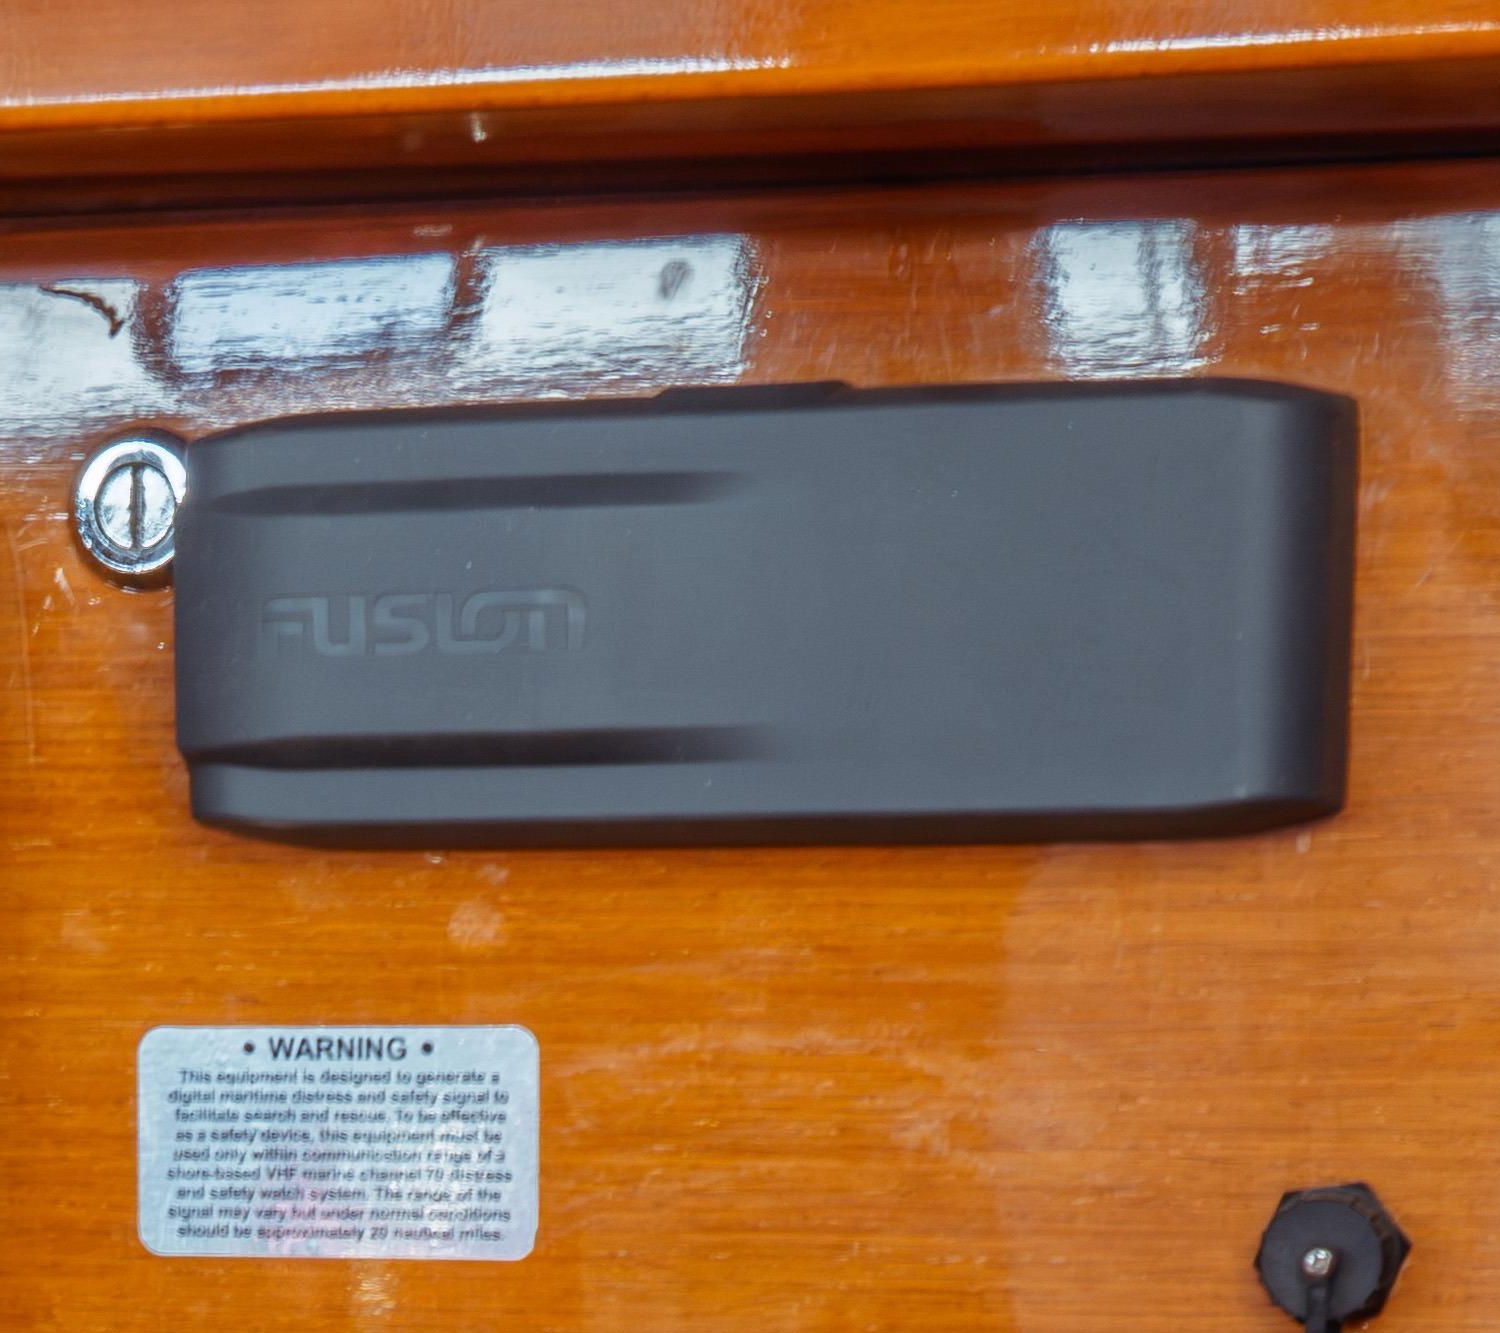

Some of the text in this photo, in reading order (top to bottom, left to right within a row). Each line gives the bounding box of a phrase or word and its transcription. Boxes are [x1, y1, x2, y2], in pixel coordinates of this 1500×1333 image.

[268, 1037, 407, 1061] WARNING
[216, 1070, 297, 1084] equipment
[320, 1070, 391, 1085] designed
[416, 1072, 485, 1085] generate
[168, 1090, 215, 1106] digital
[220, 1089, 288, 1104] maritime
[358, 1090, 386, 1104] and
[391, 1090, 439, 1107] safety
[175, 1109, 239, 1122] facilitate
[244, 1109, 296, 1122] search
[301, 1109, 329, 1122] and
[211, 1129, 258, 1145] safety
[267, 1168, 298, 1180] VHF
